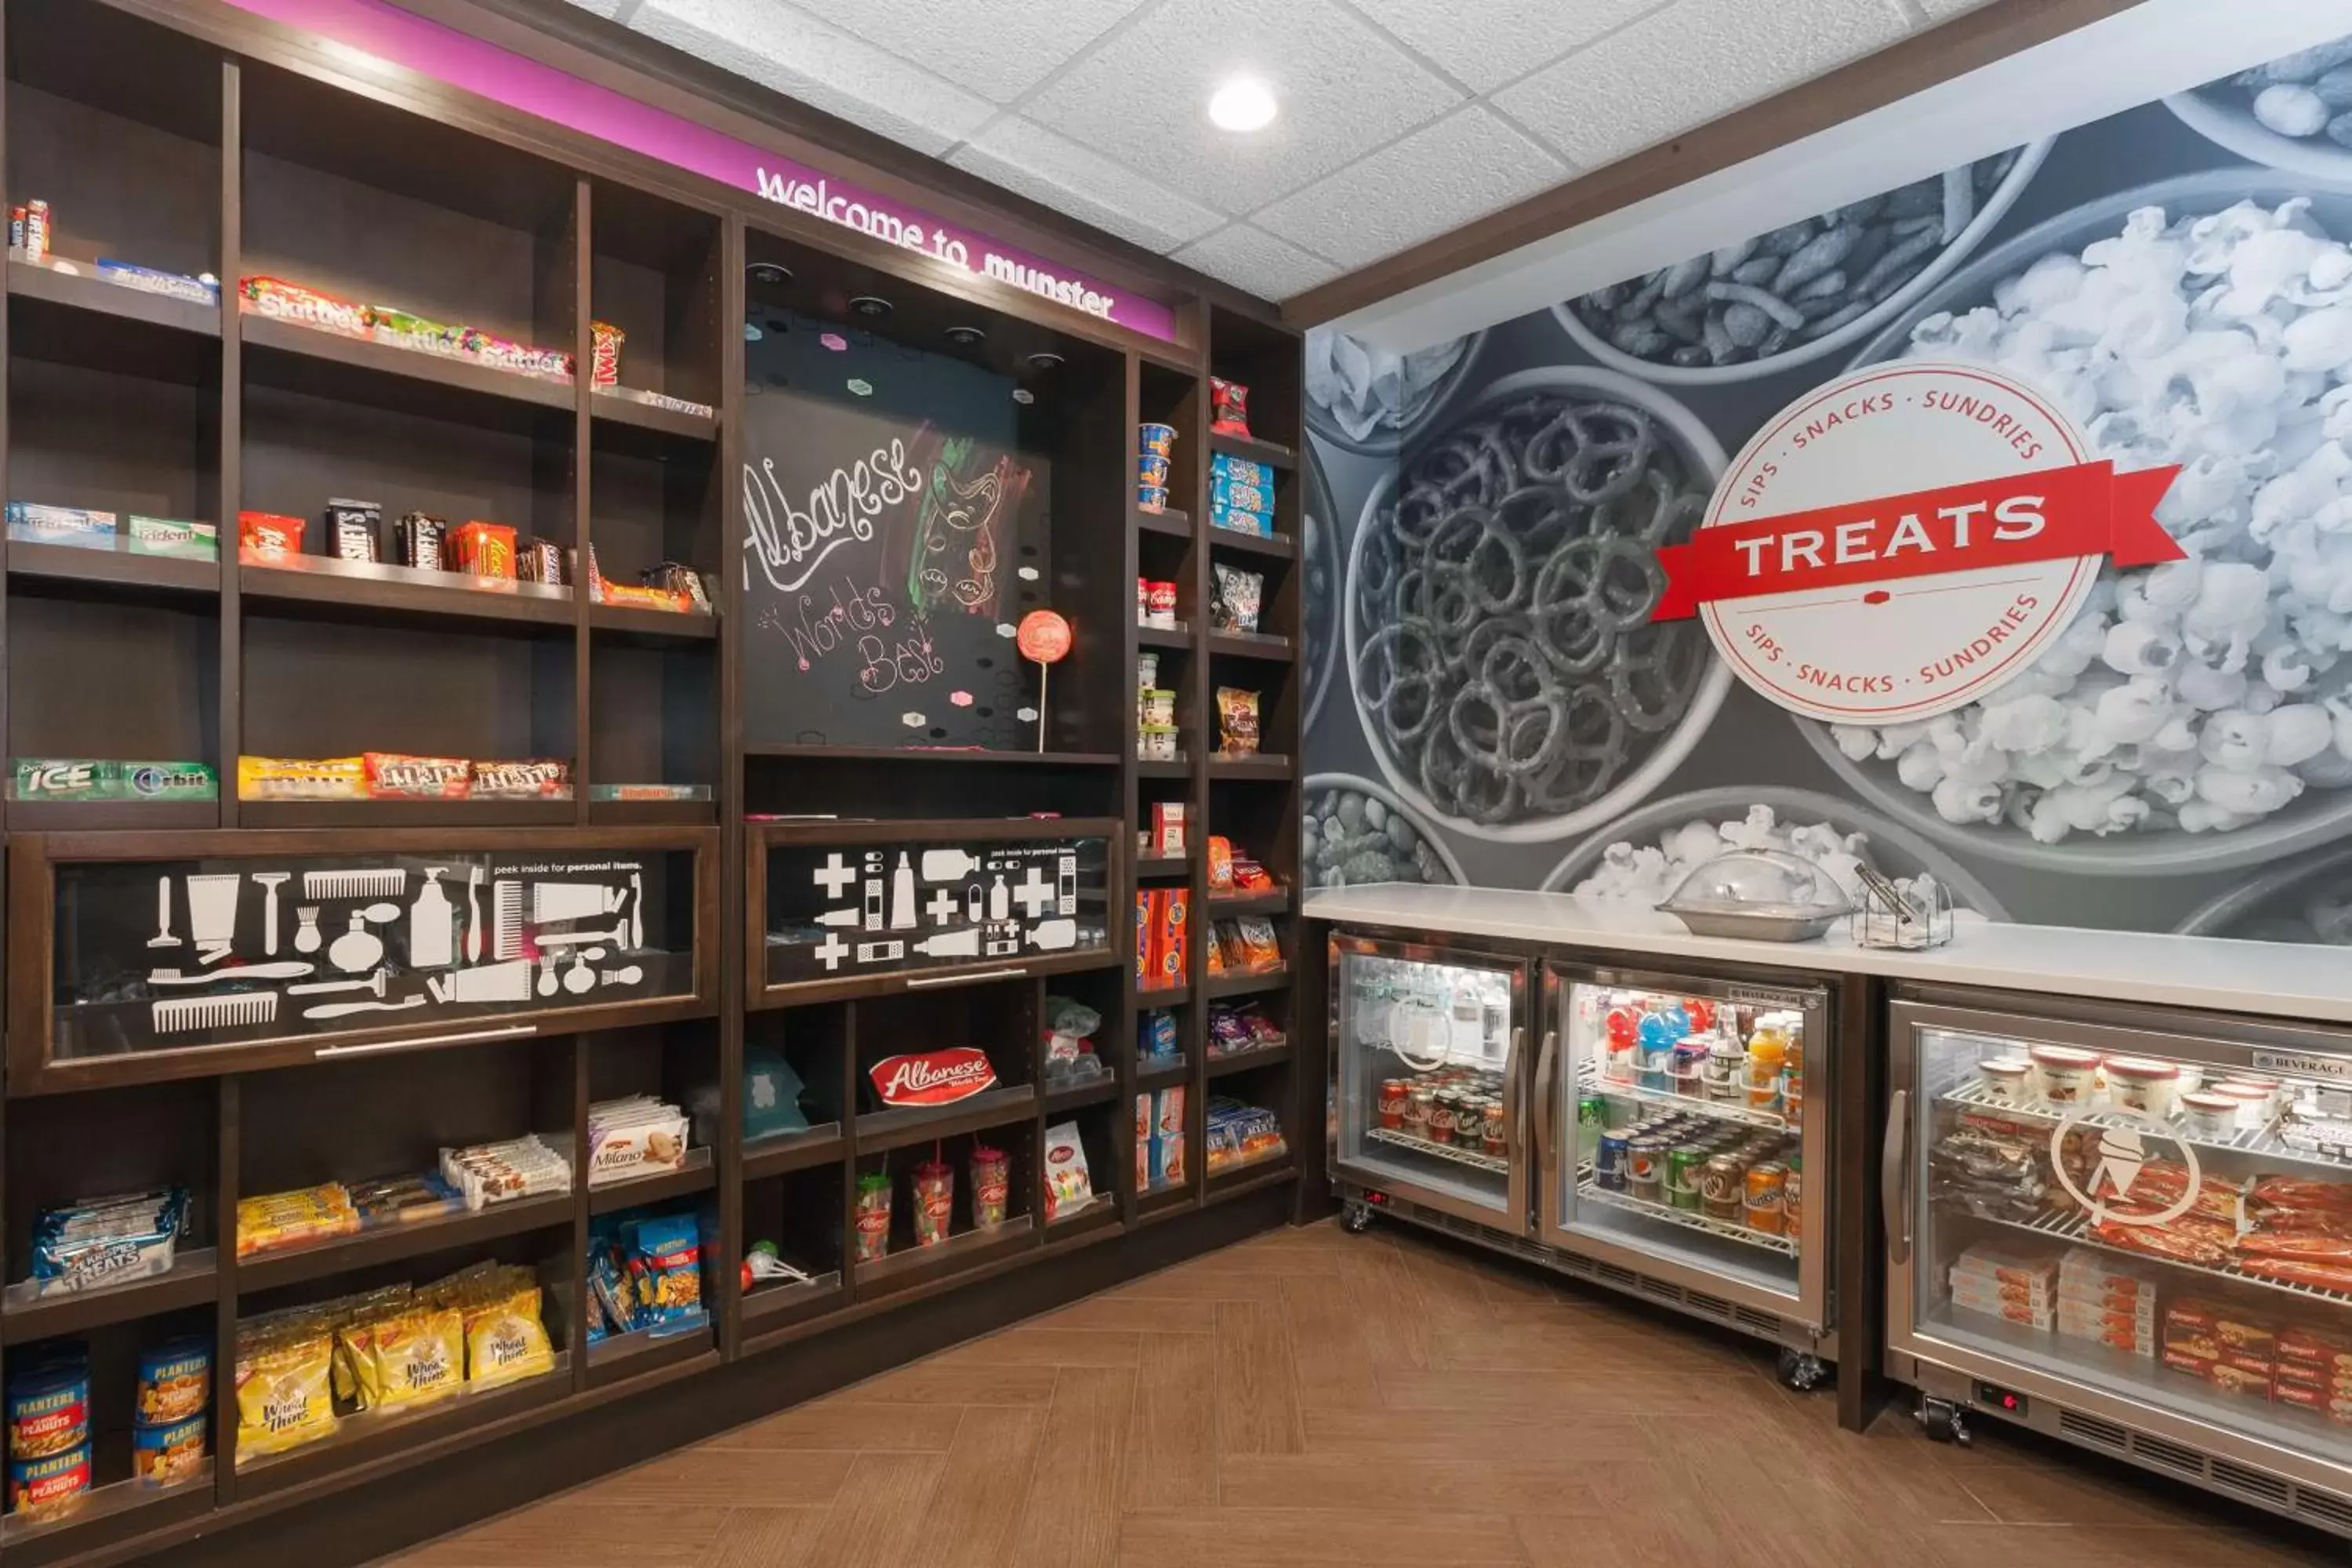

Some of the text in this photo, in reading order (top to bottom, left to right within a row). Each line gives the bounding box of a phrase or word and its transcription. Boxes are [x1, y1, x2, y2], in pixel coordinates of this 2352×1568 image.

[757, 167, 1114, 318] welcome to munster
[258, 292, 366, 334] Skittles
[1740, 389, 2044, 508] SIPS SNACKS SUNDRIES
[743, 437, 922, 592] Albanese
[338, 511, 370, 564] SHEY'S
[416, 517, 439, 571] RSHEY'S
[1733, 494, 2047, 578] TREATS
[1746, 592, 2039, 693] SIPS SNACKS SUNDRIES
[28, 763, 95, 792] ICE
[132, 765, 207, 796] Orbit
[494, 864, 518, 875] peek
[521, 863, 549, 873] inside
[551, 863, 564, 873] for
[567, 862, 611, 873] personal
[885, 1056, 988, 1098] Albanese
[2276, 1057, 2344, 1075] BEVERAGE
[595, 1149, 641, 1167] Milano
[64, 1251, 139, 1292] TREATS
[491, 1336, 526, 1357] Wheat
[407, 1357, 445, 1378] Wheat
[17, 1392, 75, 1415] PLANTERS
[263, 1396, 307, 1421] Wheat
[22, 1415, 71, 1436] PEANUTS
[270, 1410, 309, 1432] Thins
[25, 1450, 85, 1479] PLANTERS
[32, 1474, 80, 1498] PEANUTS
